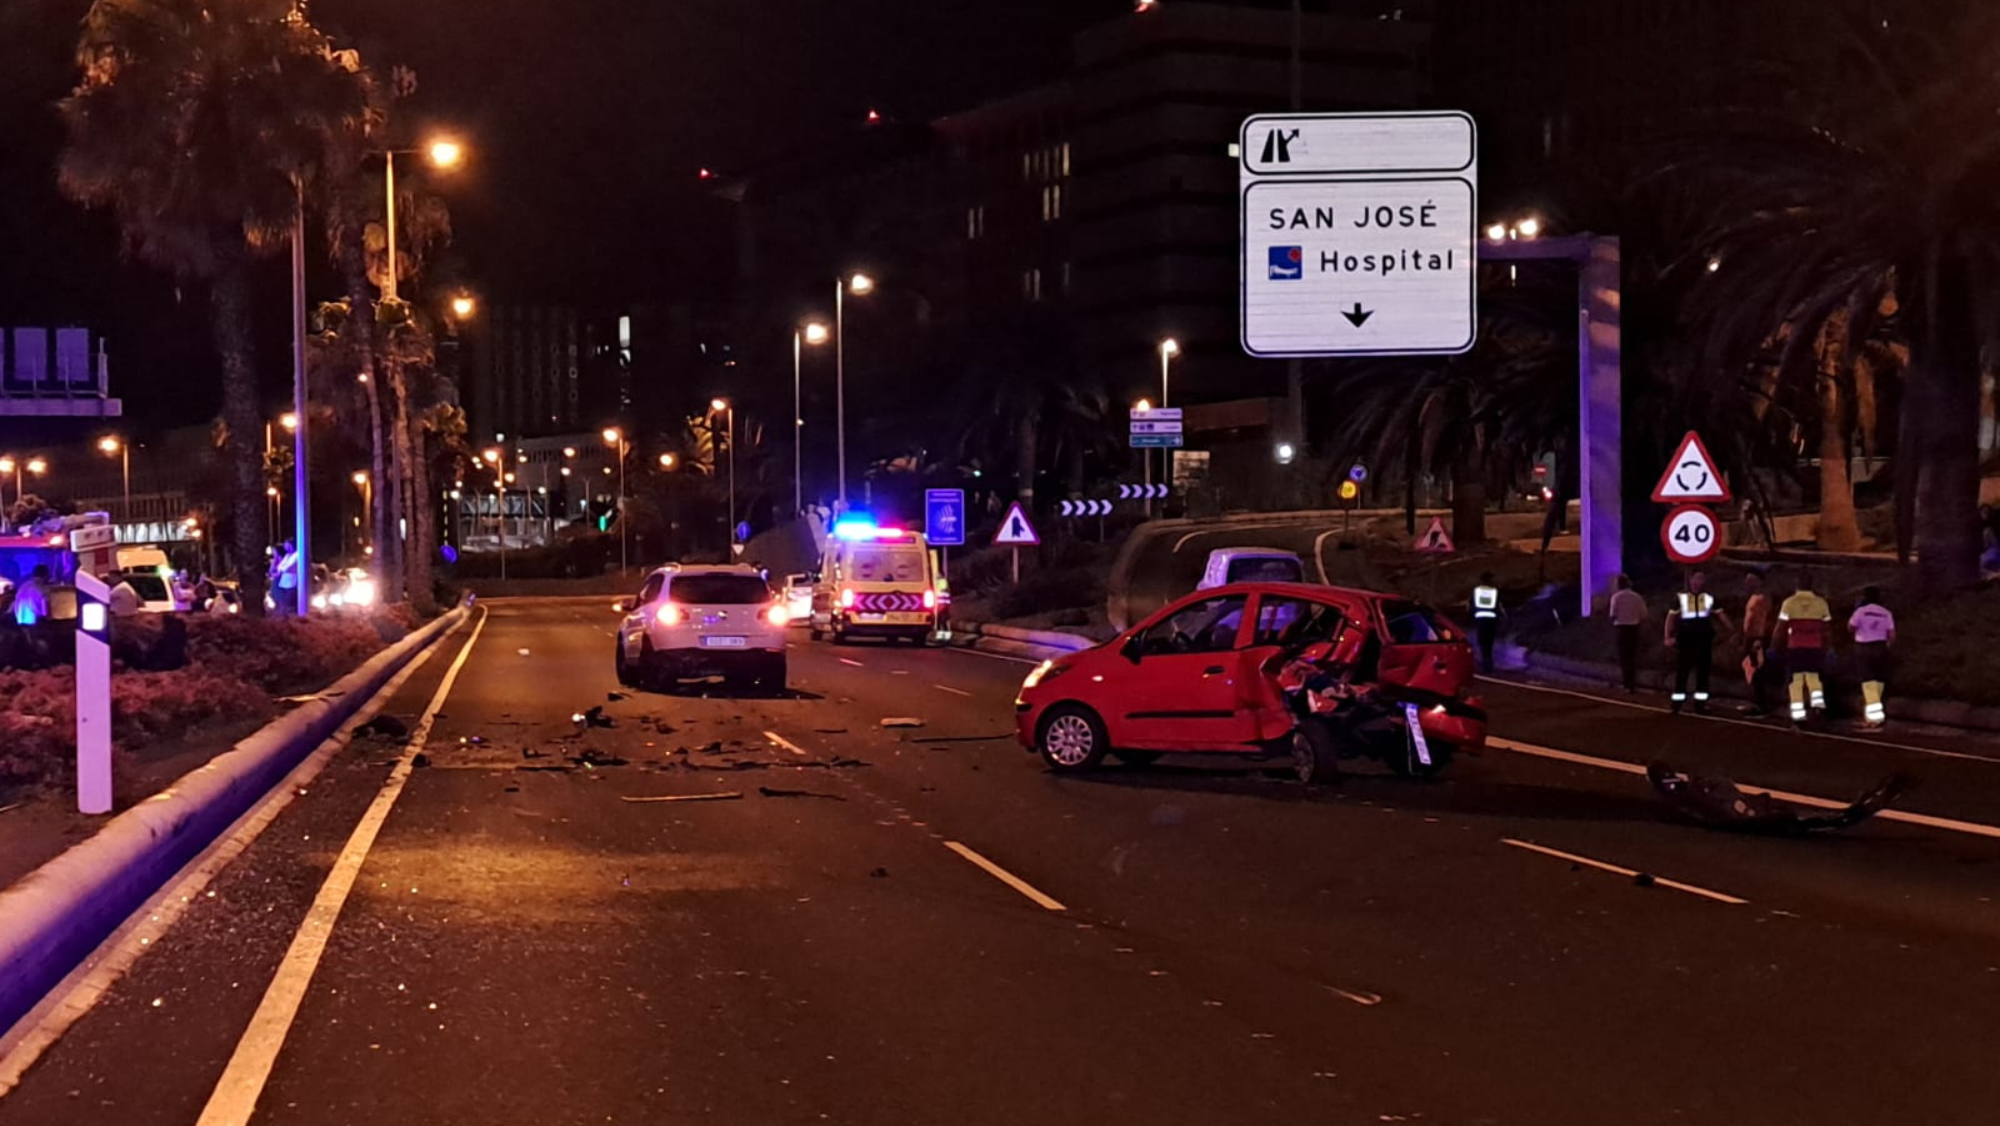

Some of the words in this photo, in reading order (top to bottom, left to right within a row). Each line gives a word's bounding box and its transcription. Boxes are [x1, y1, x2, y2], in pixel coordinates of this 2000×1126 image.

[1269, 207, 1334, 230] SAN
[1353, 199, 1437, 228] JOSÉ
[1320, 248, 1453, 276] Hospital
[1674, 524, 1711, 544] 40
